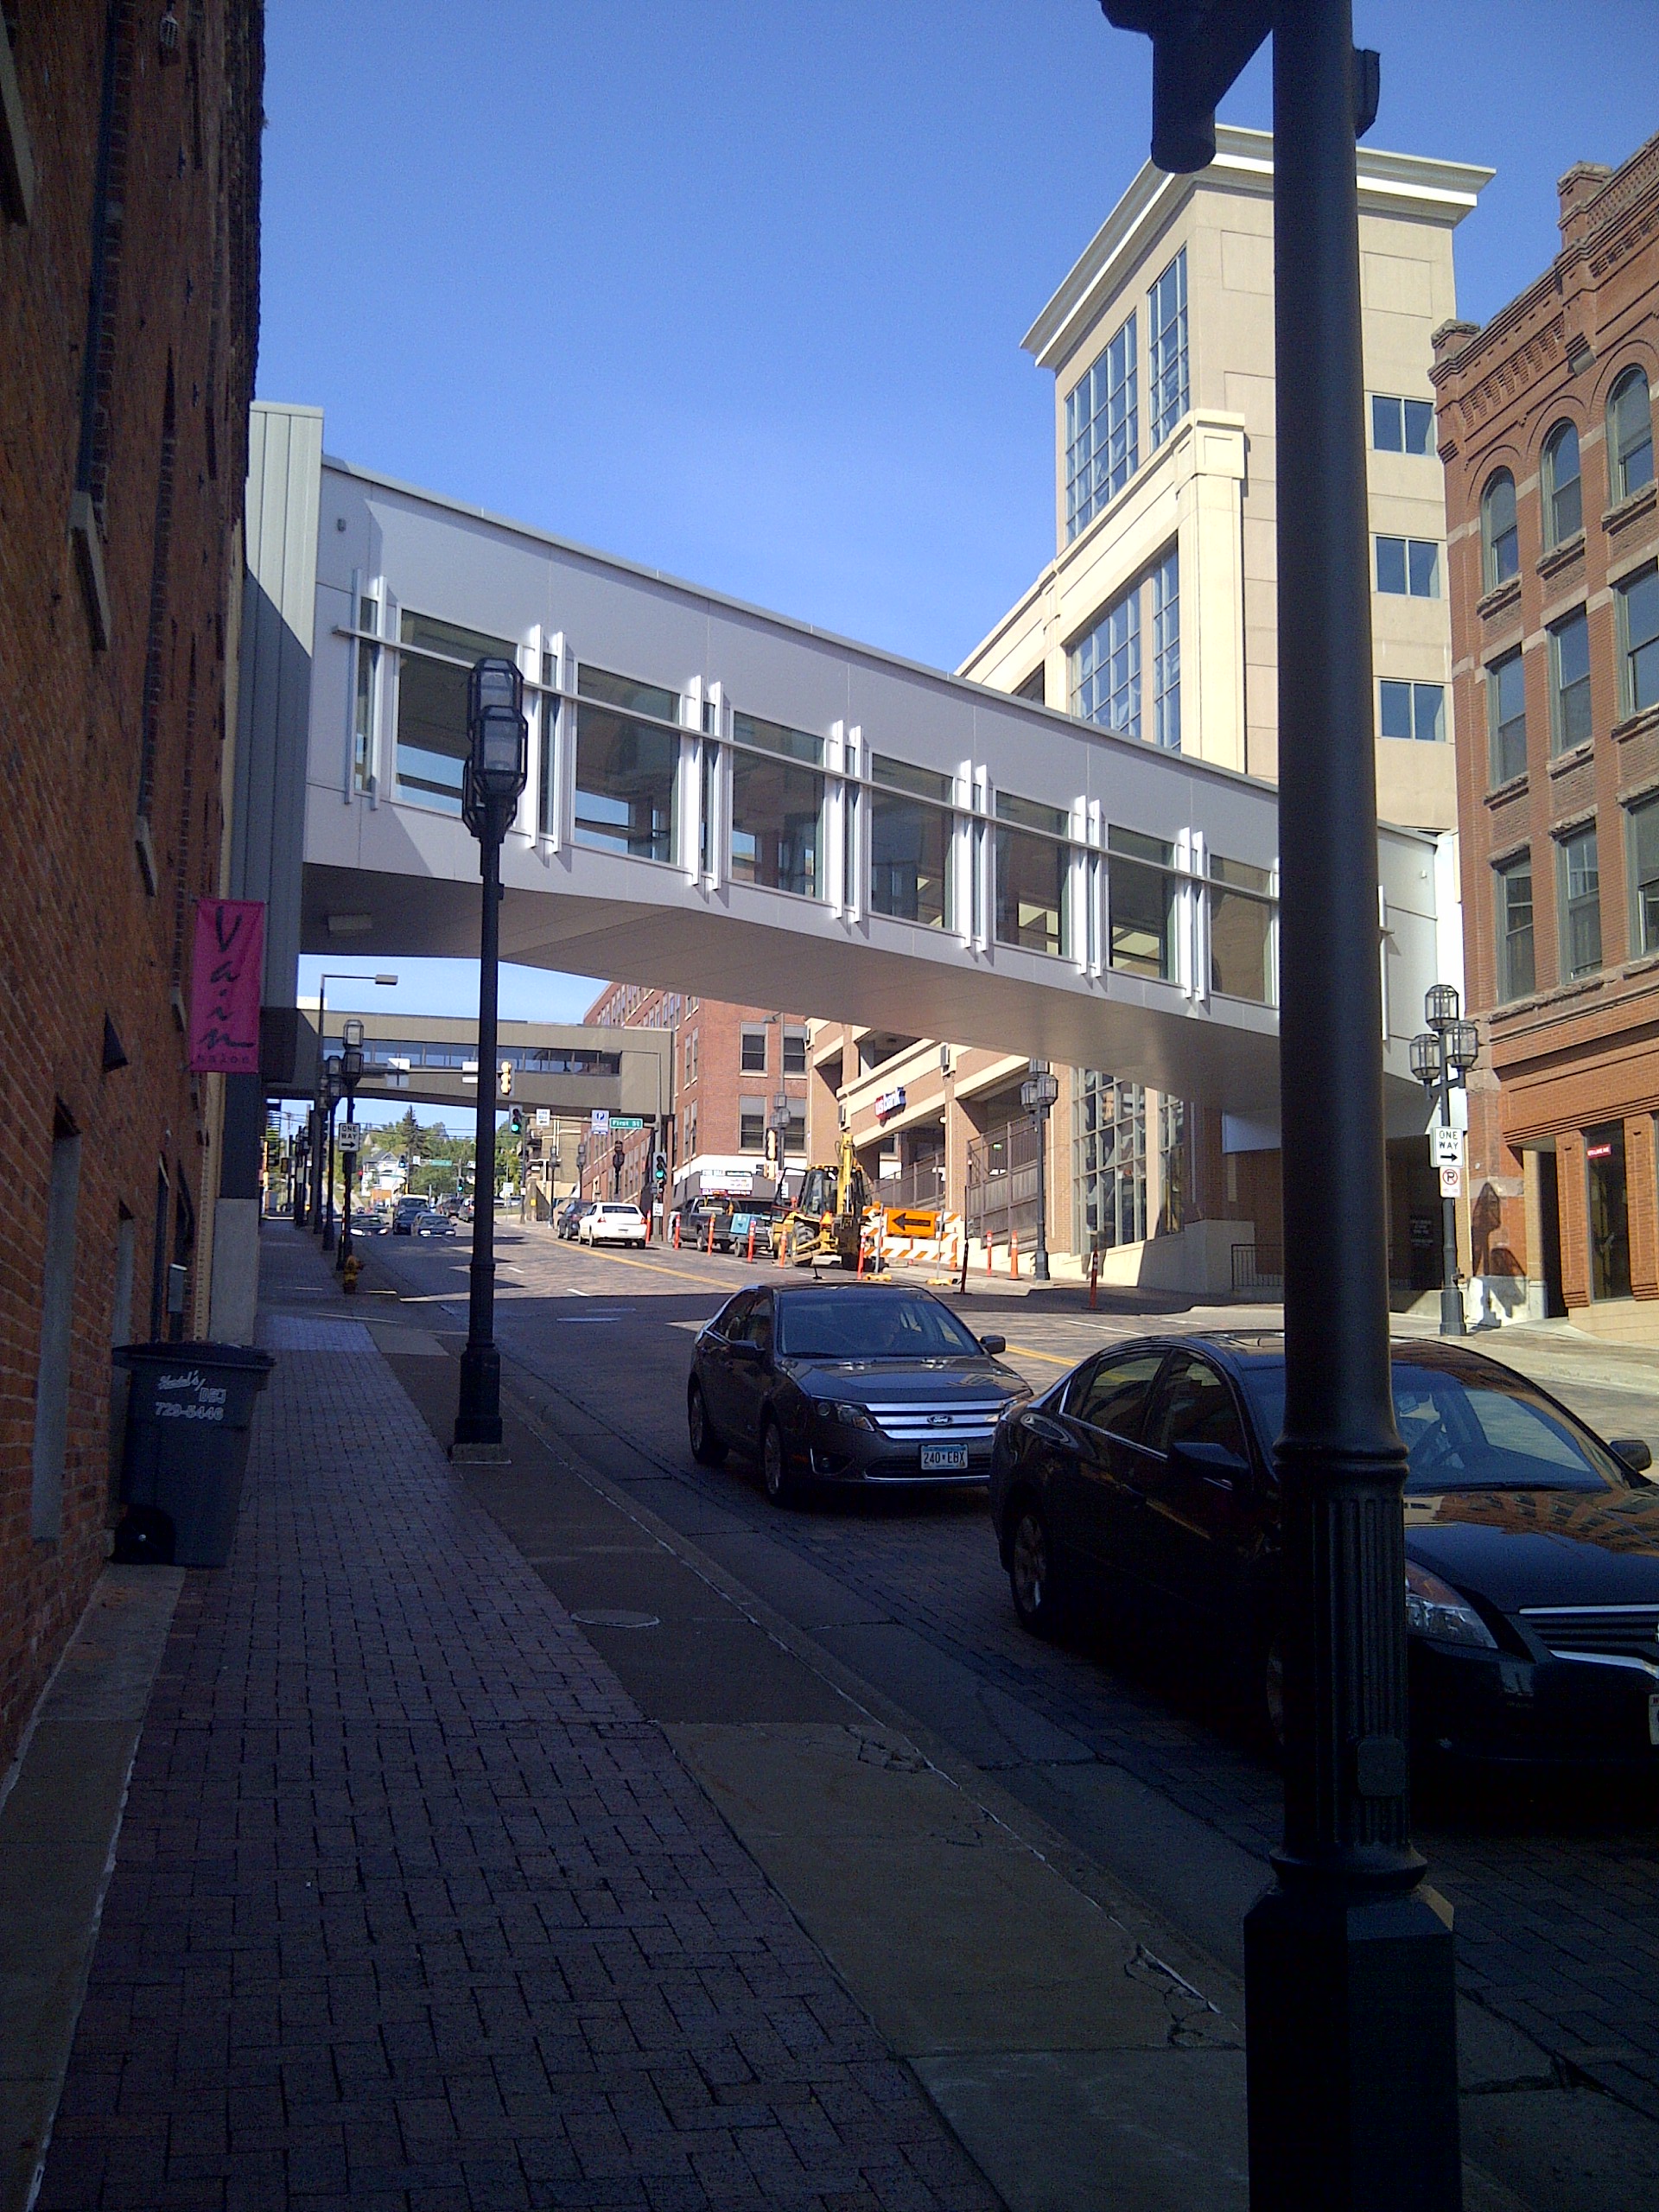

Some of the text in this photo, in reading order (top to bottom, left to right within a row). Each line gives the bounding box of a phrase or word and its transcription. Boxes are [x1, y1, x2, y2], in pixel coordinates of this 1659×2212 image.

[198, 906, 257, 1049] Vain
[1439, 1130, 1459, 1140] ONE
[1439, 1141, 1459, 1150] WAY
